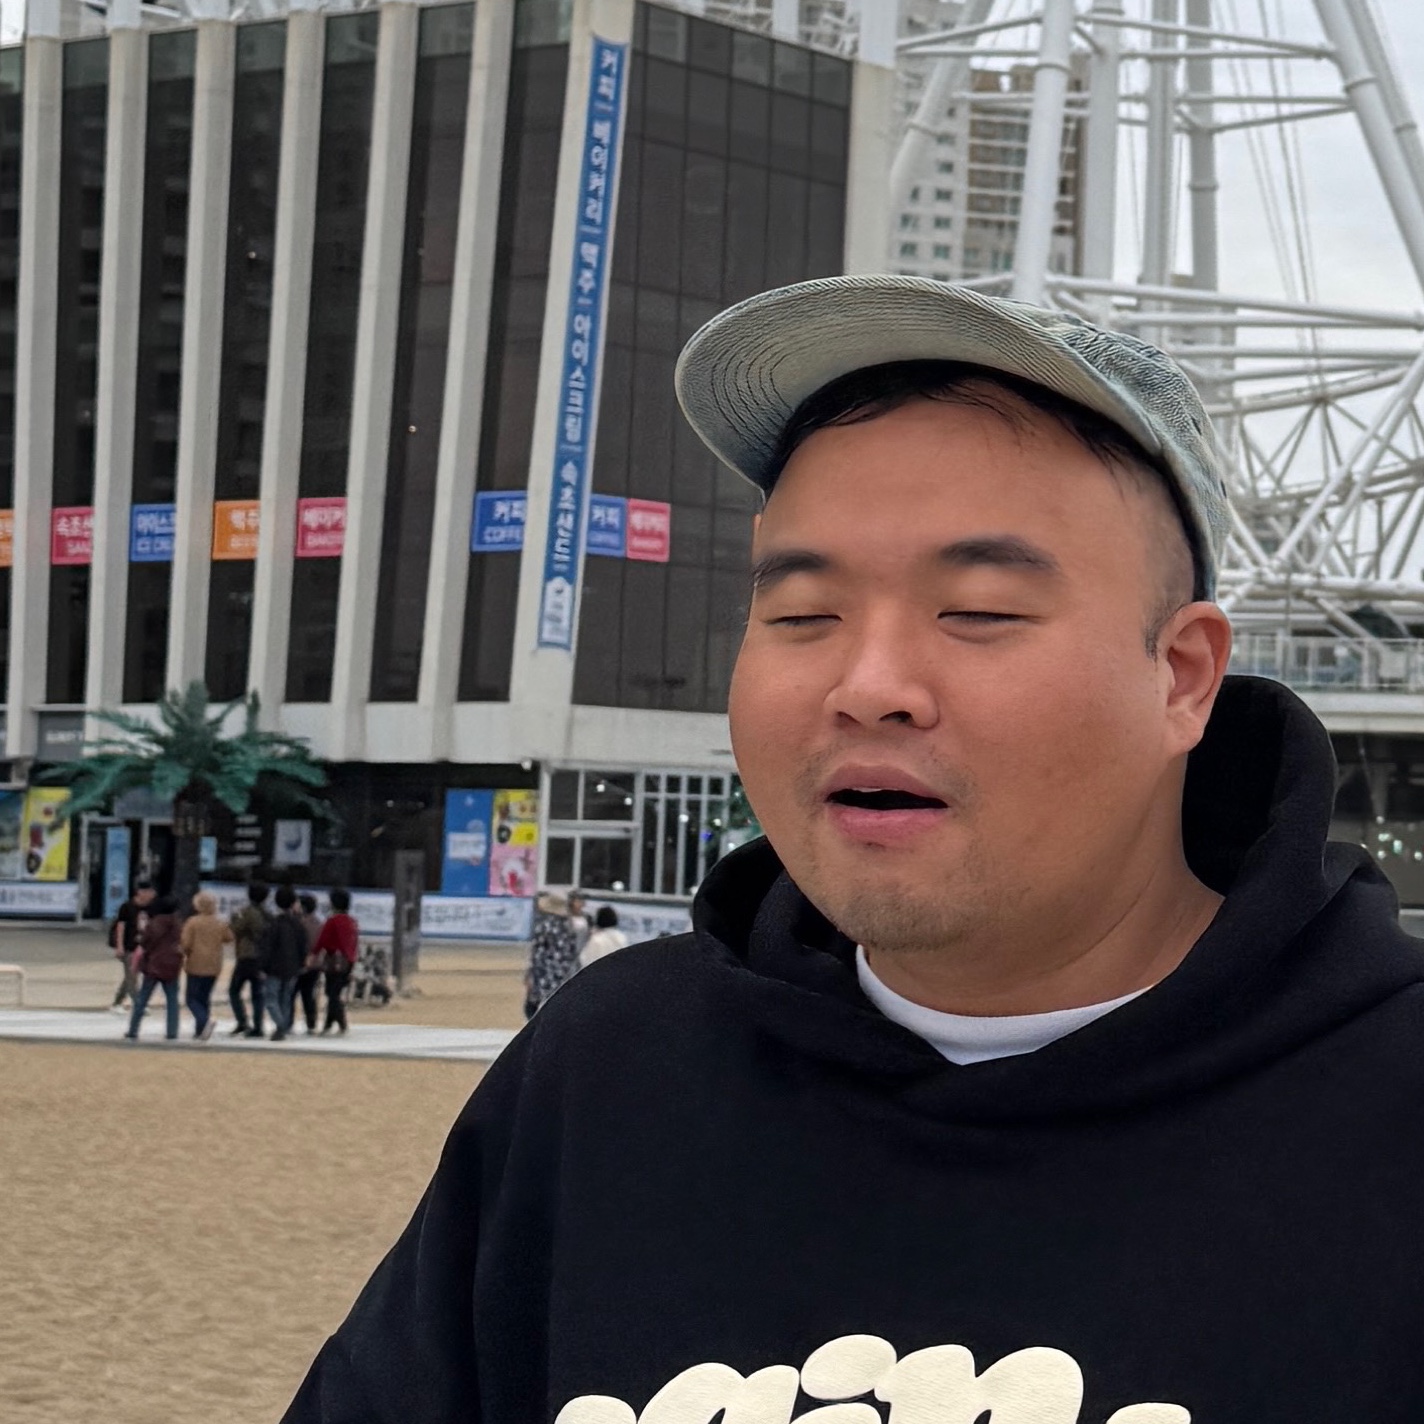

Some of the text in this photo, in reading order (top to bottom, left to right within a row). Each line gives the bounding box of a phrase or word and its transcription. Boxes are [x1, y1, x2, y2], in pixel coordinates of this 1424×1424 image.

[597, 49, 620, 100] 커피
[585, 119, 612, 225] 베이커리
[564, 313, 592, 443] 아이스크림
